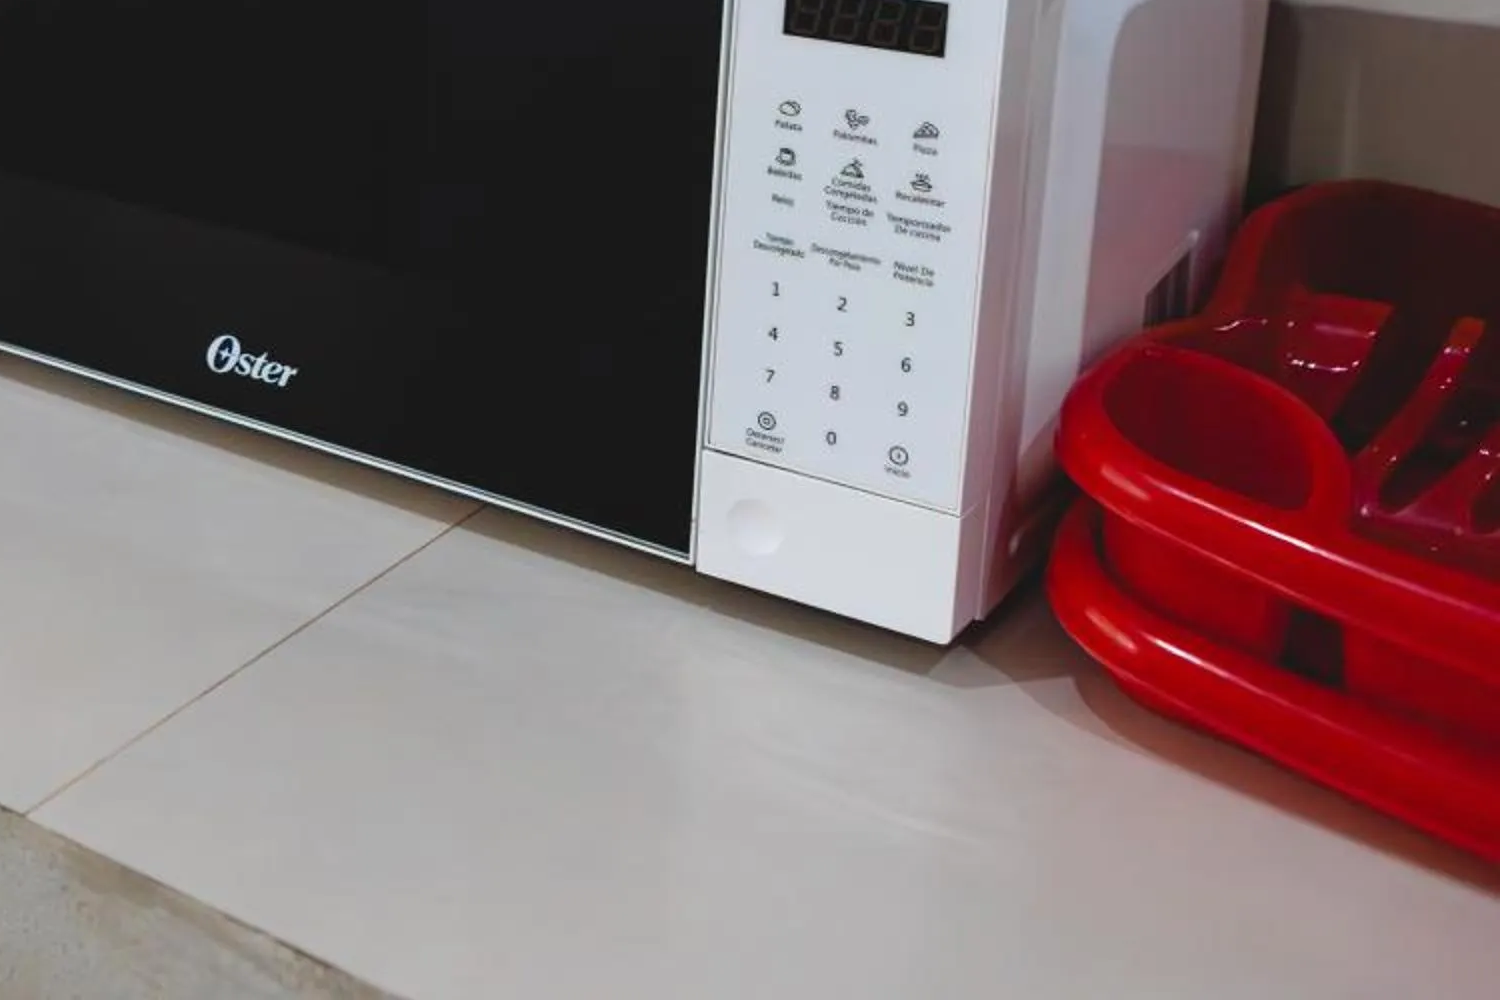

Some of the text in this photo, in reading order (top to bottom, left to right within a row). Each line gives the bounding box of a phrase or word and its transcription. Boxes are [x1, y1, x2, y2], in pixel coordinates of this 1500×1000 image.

[772, 281, 780, 296] 1
[837, 296, 848, 312] 2
[905, 312, 915, 327] 3
[768, 327, 779, 341] 4
[833, 341, 844, 357] 5
[207, 335, 299, 387] Oster
[901, 357, 912, 373] 6
[765, 369, 775, 383] 7
[829, 385, 840, 400] 8
[897, 401, 908, 417] 9
[826, 431, 837, 446] 0
